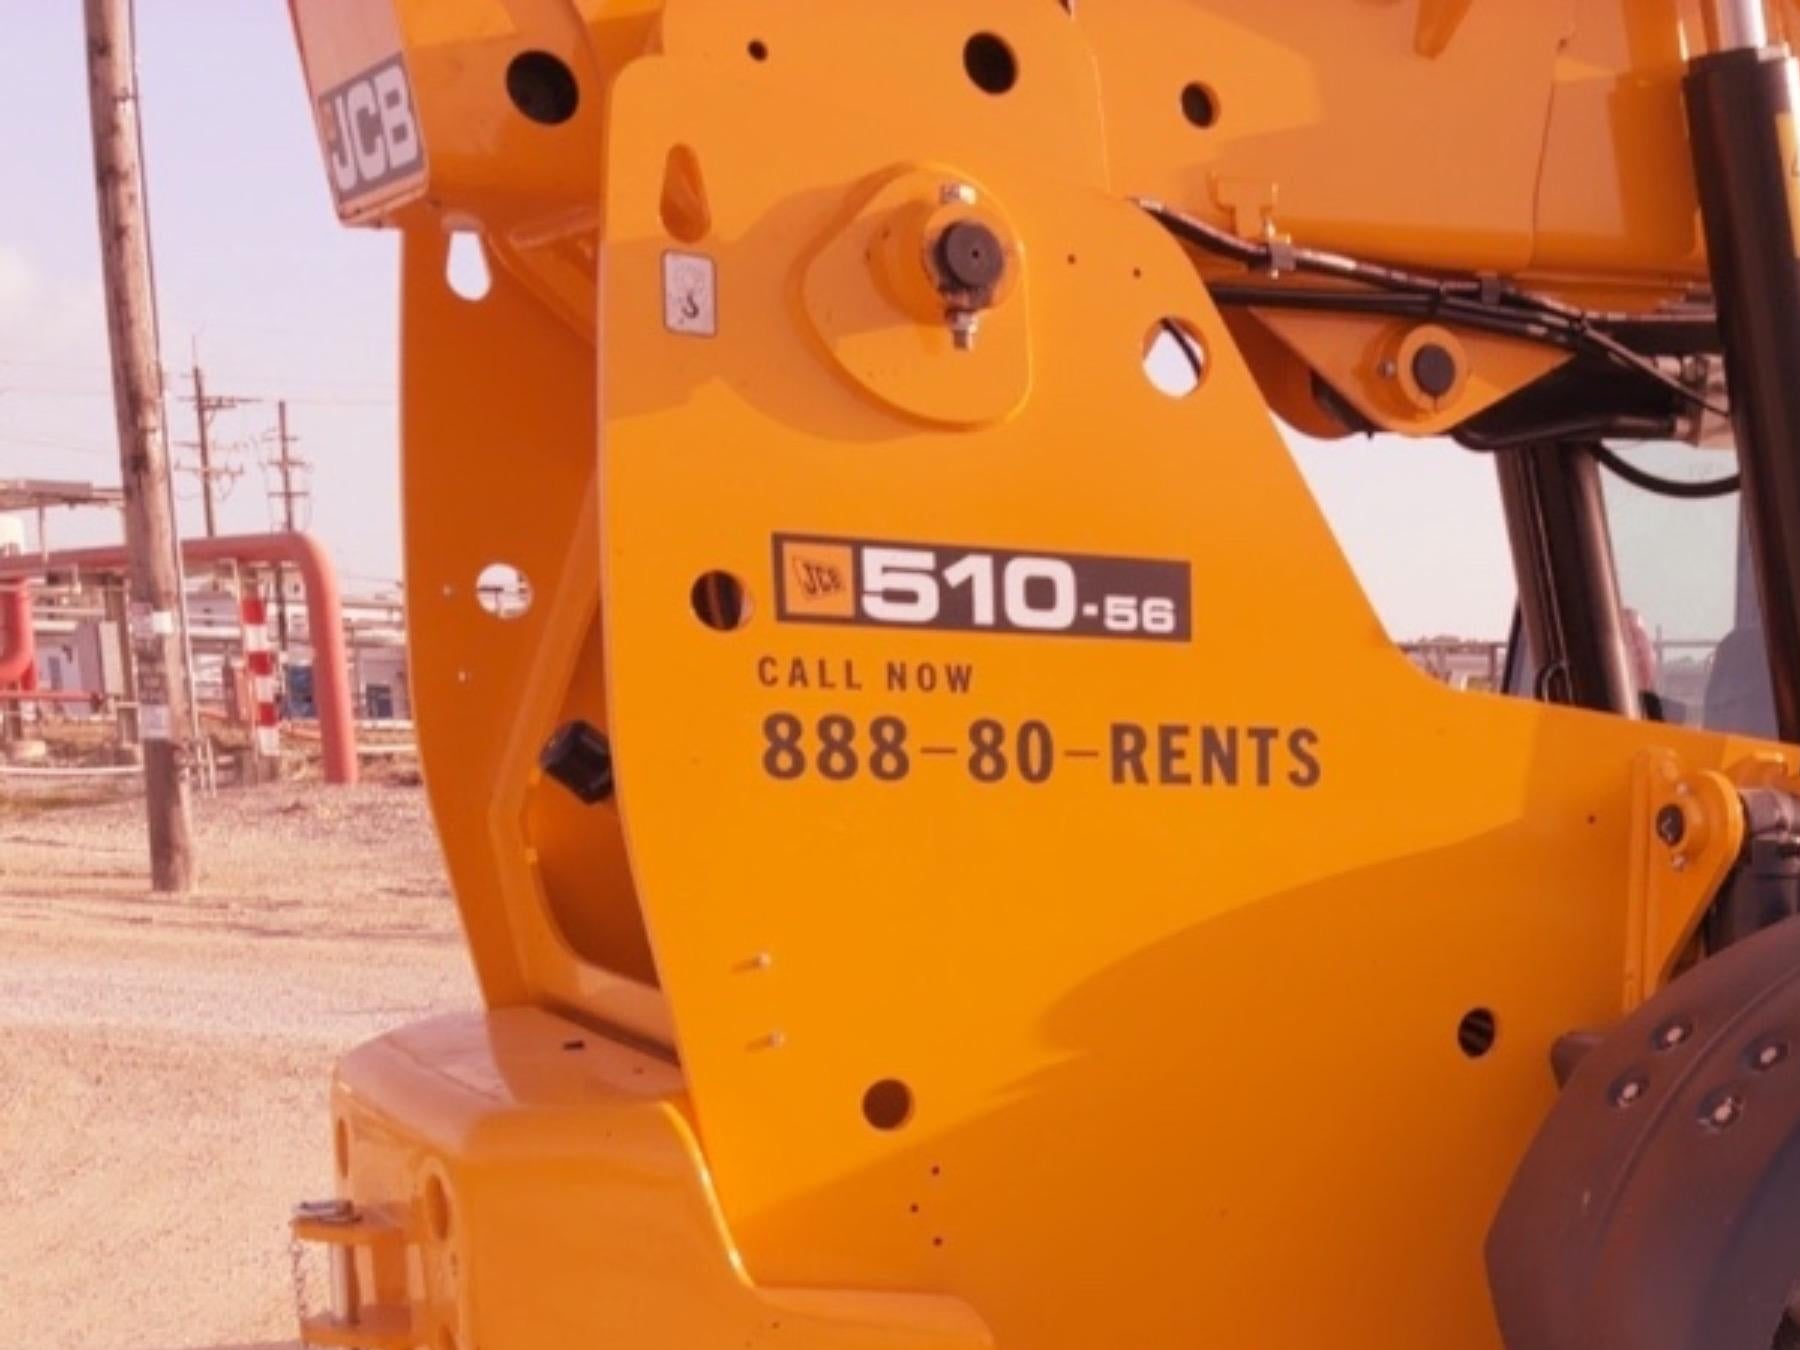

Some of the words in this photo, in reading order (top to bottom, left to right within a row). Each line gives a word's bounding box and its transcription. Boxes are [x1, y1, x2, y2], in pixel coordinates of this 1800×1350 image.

[331, 64, 419, 191] JCB
[860, 546, 1176, 634] 510-56
[757, 656, 863, 690] CALL
[886, 661, 974, 694] NOW
[760, 711, 1322, 789] 888-80-RENTS
